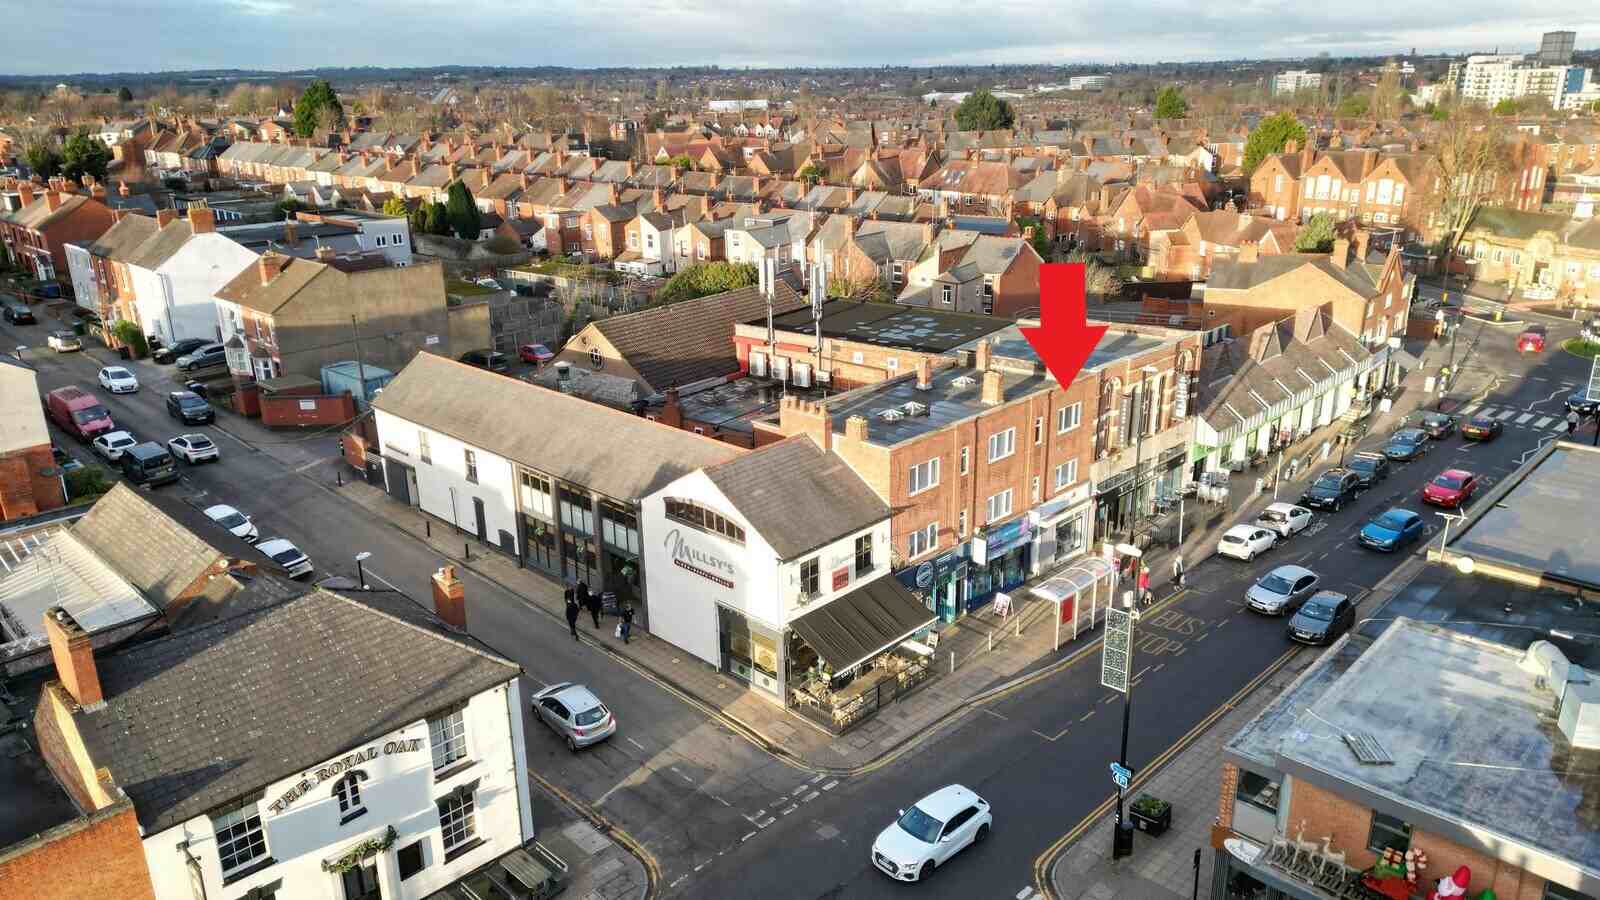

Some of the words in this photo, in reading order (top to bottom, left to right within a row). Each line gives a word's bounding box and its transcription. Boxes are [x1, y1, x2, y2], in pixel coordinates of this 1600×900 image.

[1151, 609, 1205, 635] BUS
[267, 778, 313, 815] THE
[314, 747, 378, 784] ROYAL
[383, 737, 427, 756] OAK
